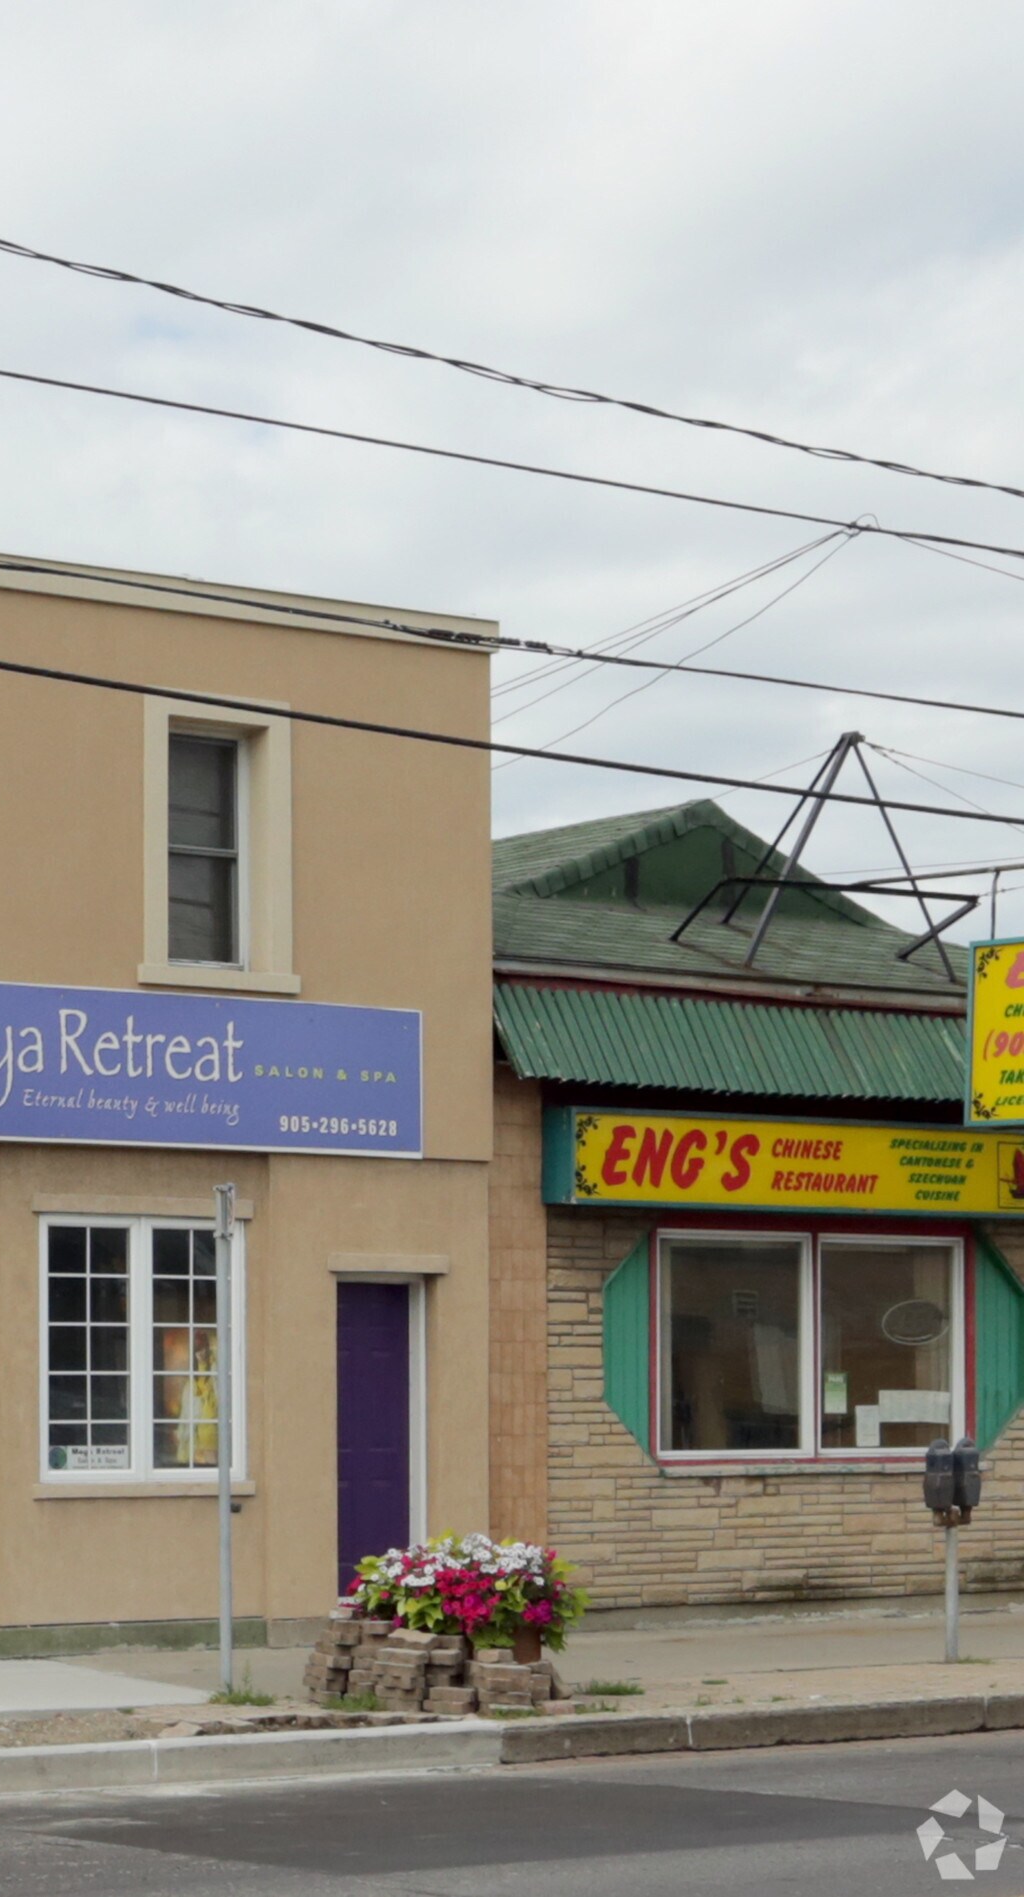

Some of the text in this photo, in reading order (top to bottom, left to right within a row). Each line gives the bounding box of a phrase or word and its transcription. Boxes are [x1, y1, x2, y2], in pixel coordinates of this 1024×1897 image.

[59, 1009, 243, 1083] Retreat
[255, 1065, 324, 1080] SALON
[336, 1069, 348, 1081] &
[361, 1070, 397, 1083] SPA
[22, 1087, 82, 1110] Eternal
[88, 1090, 138, 1118] beauty
[163, 1092, 196, 1115] well
[201, 1094, 240, 1126] being
[890, 1138, 984, 1153] SPECIALIZING IN
[601, 1125, 843, 1192] ENG'S CHINESE
[899, 1156, 963, 1168] CANTONESE
[771, 1171, 878, 1194] RESTAURANT
[909, 1173, 967, 1185] SZECHUAN
[915, 1189, 960, 1202] CUISINE
